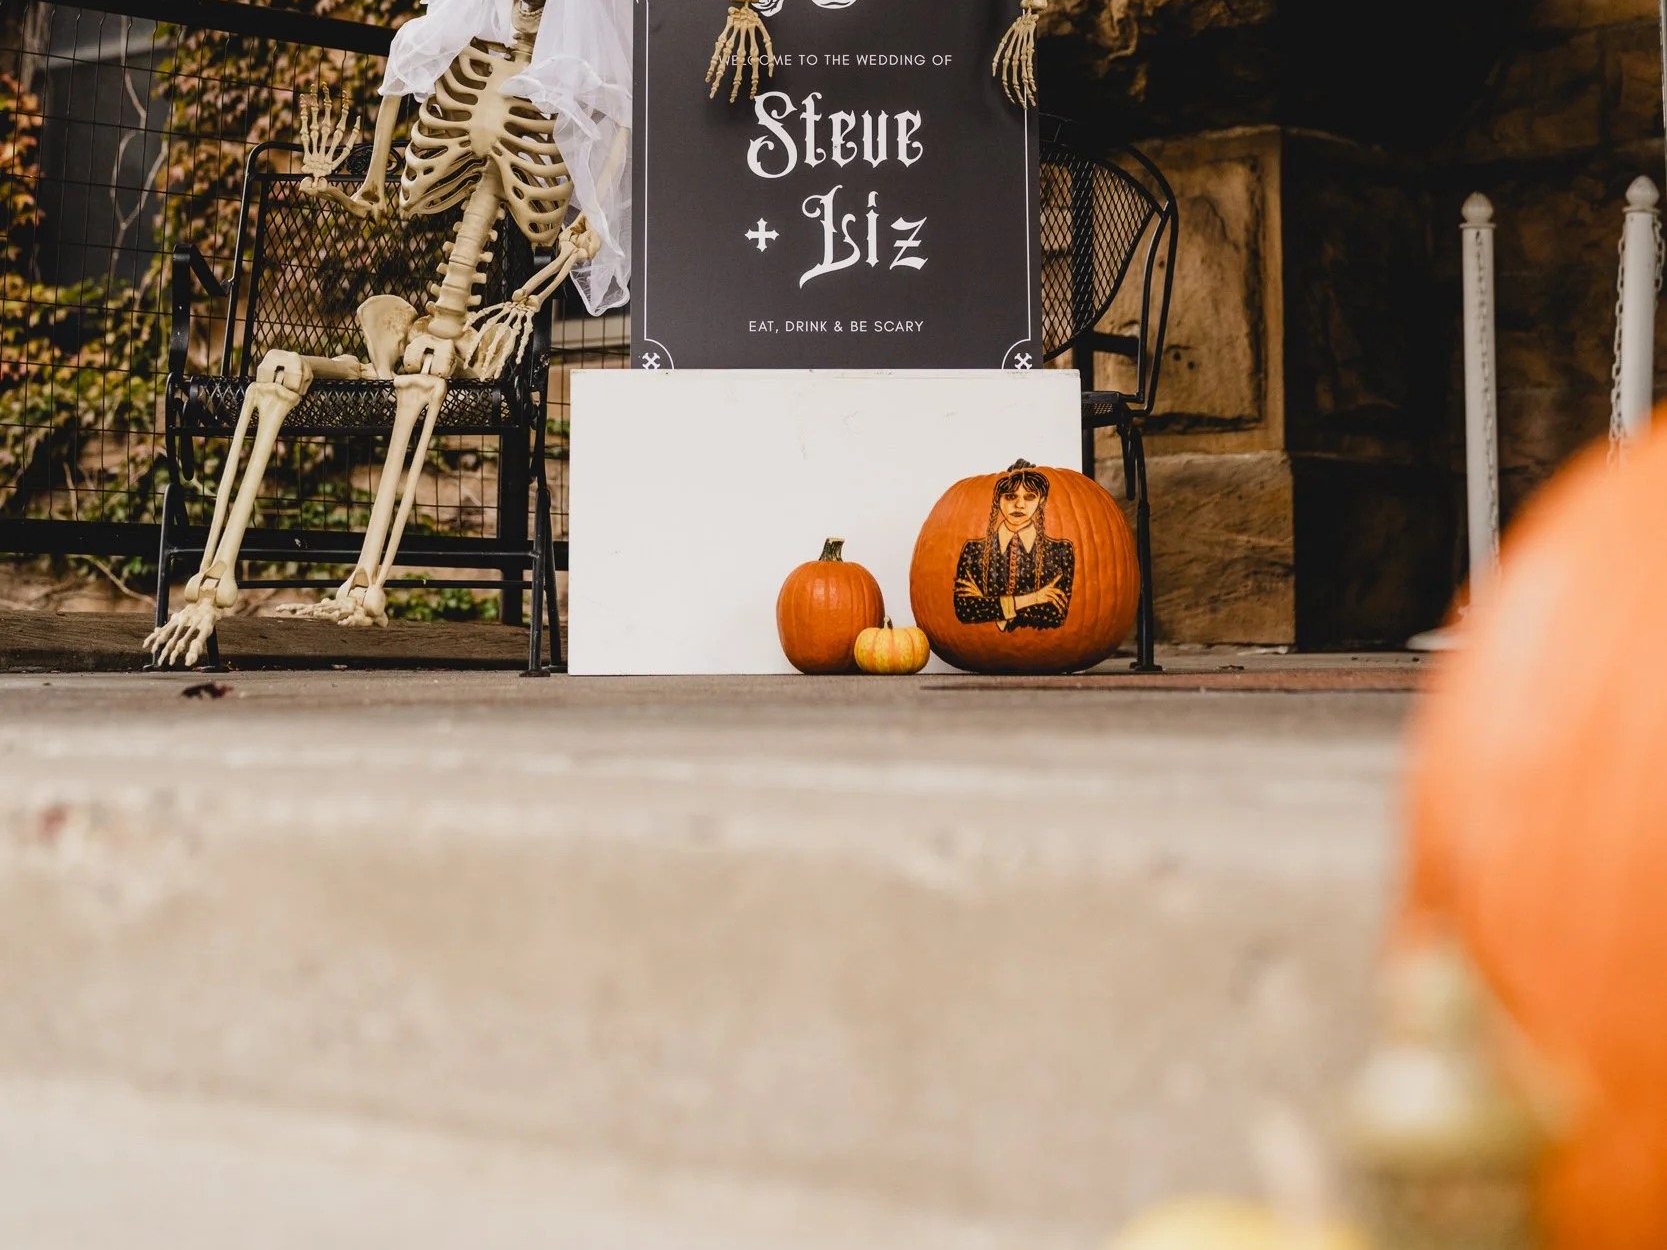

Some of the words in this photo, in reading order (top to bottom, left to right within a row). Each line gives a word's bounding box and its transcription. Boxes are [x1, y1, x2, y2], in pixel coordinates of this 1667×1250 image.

[798, 54, 818, 66] TO
[824, 54, 850, 66] THE
[856, 54, 926, 66] WEDDING
[932, 54, 953, 66] OF
[747, 91, 924, 179] Steve
[799, 184, 929, 290] Liz
[749, 320, 779, 334] EAT,
[785, 320, 827, 332] DRINK
[833, 320, 844, 332] &
[850, 320, 868, 332] BE
[874, 320, 924, 332] SCARY
